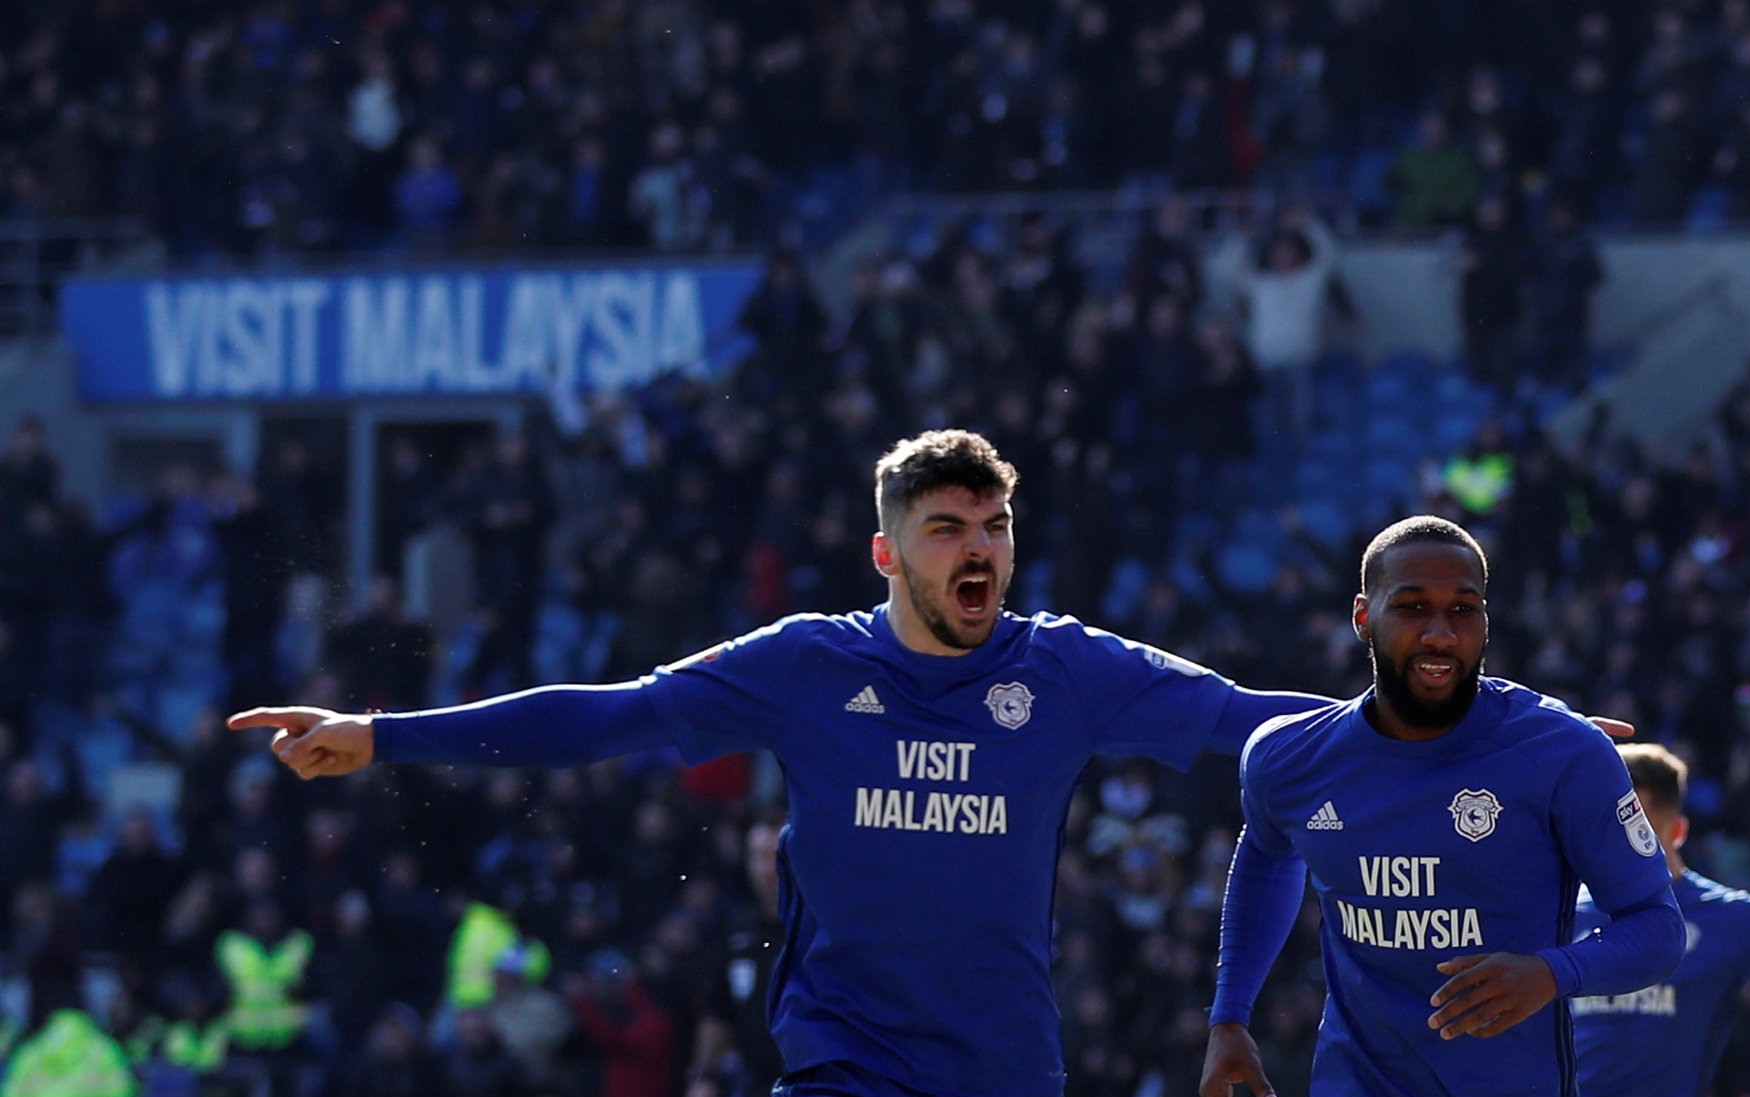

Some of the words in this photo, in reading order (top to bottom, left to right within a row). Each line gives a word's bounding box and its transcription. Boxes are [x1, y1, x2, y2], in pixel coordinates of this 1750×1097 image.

[146, 278, 330, 396] VISIT
[342, 267, 705, 393] MALAYSIA
[845, 702, 885, 714] adidas
[896, 740, 976, 782] VISIT
[855, 787, 1007, 835] MALAYSIA
[1306, 820, 1343, 831] adidas
[1359, 856, 1440, 898] VISIT
[1337, 900, 1483, 950] MALAYSIA
